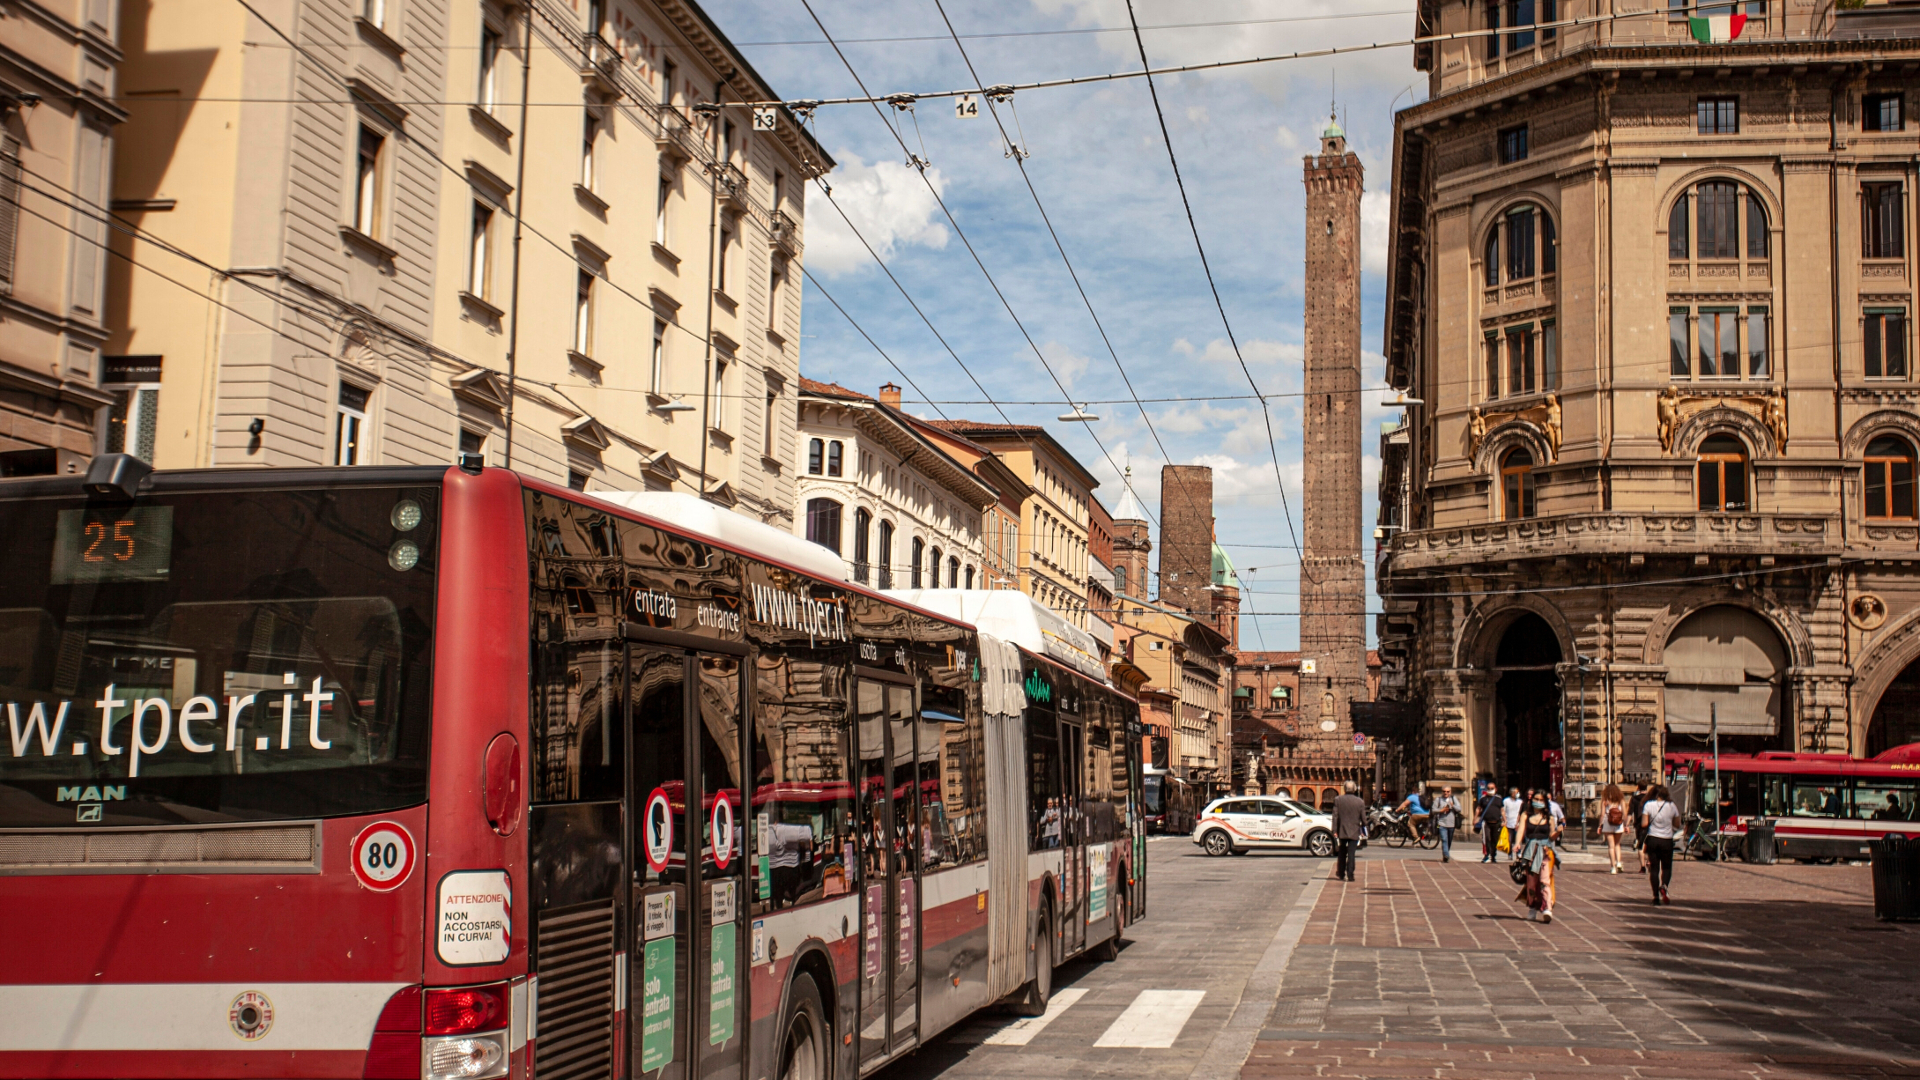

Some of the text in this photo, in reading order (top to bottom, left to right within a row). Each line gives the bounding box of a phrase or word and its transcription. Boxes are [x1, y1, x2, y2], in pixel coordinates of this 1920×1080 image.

[956, 102, 977, 116] 14
[754, 114, 774, 128] 13
[84, 520, 135, 562] 25
[635, 588, 739, 632] entrata entrance
[751, 582, 847, 649] www.tper.it
[860, 639, 877, 660] uscita
[0, 671, 335, 778] w.tper.it
[57, 785, 126, 802] MAN
[368, 842, 398, 869] 80
[647, 902, 663, 911] Prepara
[444, 911, 468, 921] NON
[444, 920, 502, 932] ACCOSTARSI
[650, 921, 664, 931] viaggio
[444, 931, 492, 942] IN CURVA!
[712, 958, 724, 976] solo
[645, 976, 660, 997] solo
[712, 974, 732, 995] entrata
[645, 993, 670, 1017] entrata
[644, 1021, 662, 1036] entrance
